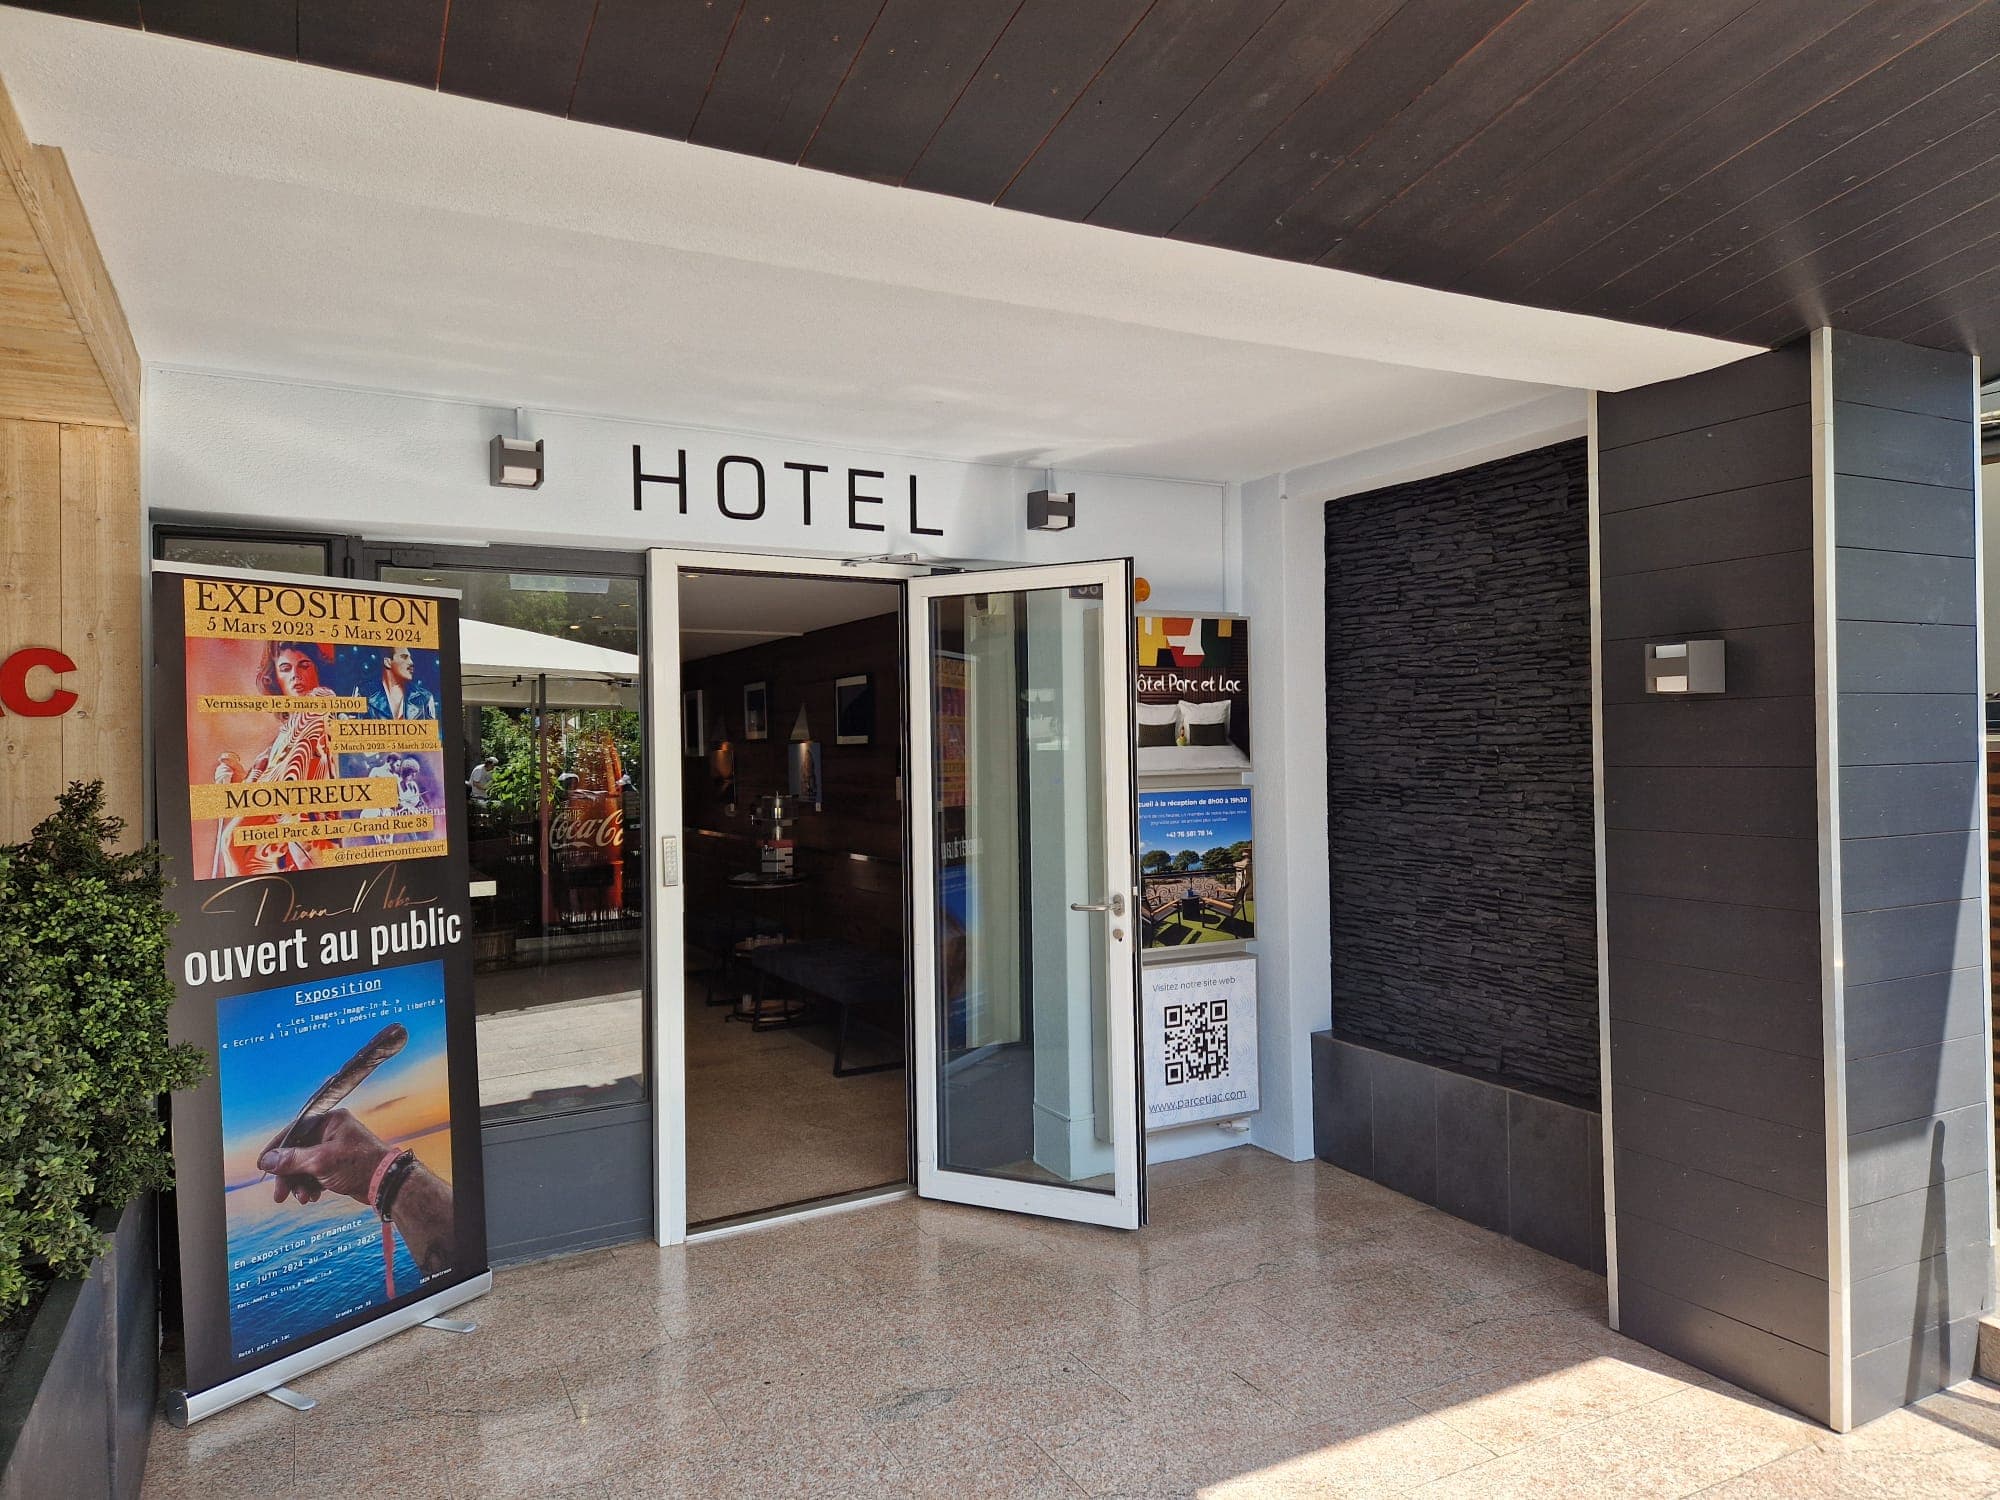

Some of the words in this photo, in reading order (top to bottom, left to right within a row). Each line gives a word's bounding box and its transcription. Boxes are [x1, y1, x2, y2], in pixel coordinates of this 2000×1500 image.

[632, 444, 944, 536] HOTEL
[195, 582, 431, 626] EXPOSITION
[207, 617, 216, 631] 5
[223, 618, 266, 634] Mars
[272, 621, 314, 636] 2023
[331, 625, 339, 638] 5
[345, 626, 381, 640] Mars
[386, 628, 422, 642] 2024
[0, 647, 78, 717] C
[1137, 674, 1166, 692] ôtel
[1169, 674, 1198, 694] Parc
[1200, 675, 1217, 692] et
[1218, 675, 1241, 694] Lac
[204, 698, 269, 711] Vernissage
[272, 699, 281, 709] le
[285, 699, 290, 709] 5
[294, 700, 319, 709] mars
[321, 699, 327, 709] à
[330, 699, 361, 709] 15h00
[339, 723, 429, 736] EXHIBITION
[333, 743, 338, 751] 5
[340, 742, 365, 751] March
[367, 743, 386, 751] 2023
[397, 741, 419, 750] March
[420, 742, 438, 750] 2024
[225, 784, 373, 810] MONTREUX
[1168, 798, 1197, 808] réception
[242, 827, 279, 842] Hôtel
[283, 825, 309, 839] Parc
[311, 825, 320, 836] &
[325, 822, 345, 836] Lac
[393, 818, 413, 829] Rue
[416, 817, 428, 828] 38
[334, 844, 446, 863] @freddiemontreuxart
[184, 929, 308, 986] ouvert
[320, 930, 359, 965] au
[371, 907, 462, 966] public
[295, 977, 382, 1004] Exposition
[1152, 983, 1179, 992] Visitez
[1180, 981, 1202, 990] notre
[1203, 978, 1217, 987] site
[1218, 976, 1236, 985] web
[233, 1034, 265, 1047] Ecrire
[280, 1029, 289, 1038] la
[336, 1015, 346, 1024] la
[380, 1007, 390, 1016] de
[394, 1005, 402, 1014] la
[407, 998, 436, 1012] liberté
[234, 1260, 246, 1270] En
[251, 1239, 306, 1264] exposition
[310, 1219, 362, 1244] permanente
[235, 1279, 251, 1291] 1er
[257, 1270, 278, 1284] juin
[282, 1259, 303, 1274] 2024
[308, 1255, 319, 1264] au
[323, 1250, 333, 1259] 25
[337, 1243, 352, 1253] Mai
[357, 1233, 377, 1247] 2025
